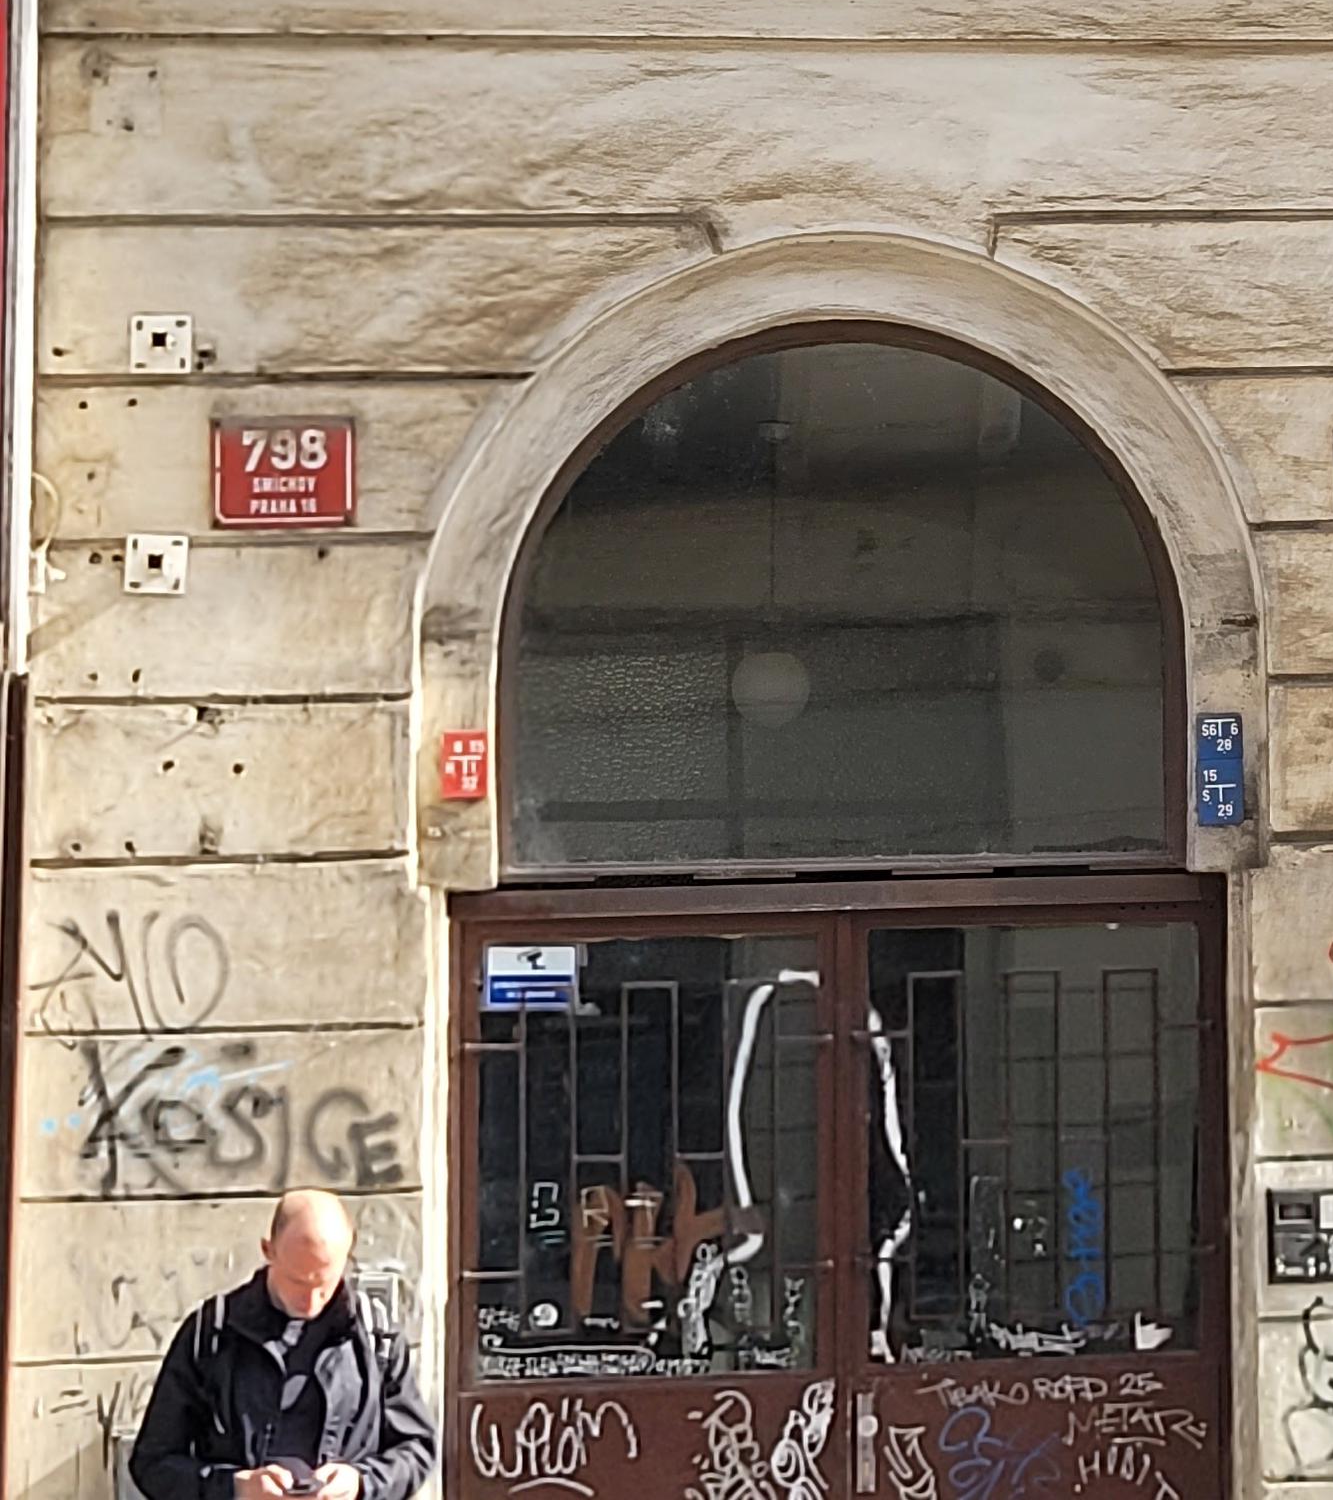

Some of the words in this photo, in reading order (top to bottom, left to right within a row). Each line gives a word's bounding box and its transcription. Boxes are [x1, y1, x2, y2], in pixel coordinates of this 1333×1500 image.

[242, 428, 328, 473] 798
[1201, 723, 1217, 737] S6
[1230, 722, 1239, 736] 6
[1216, 738, 1232, 752] 28
[1203, 769, 1218, 782] 15
[1202, 790, 1211, 802] S
[1217, 803, 1233, 817] 29
